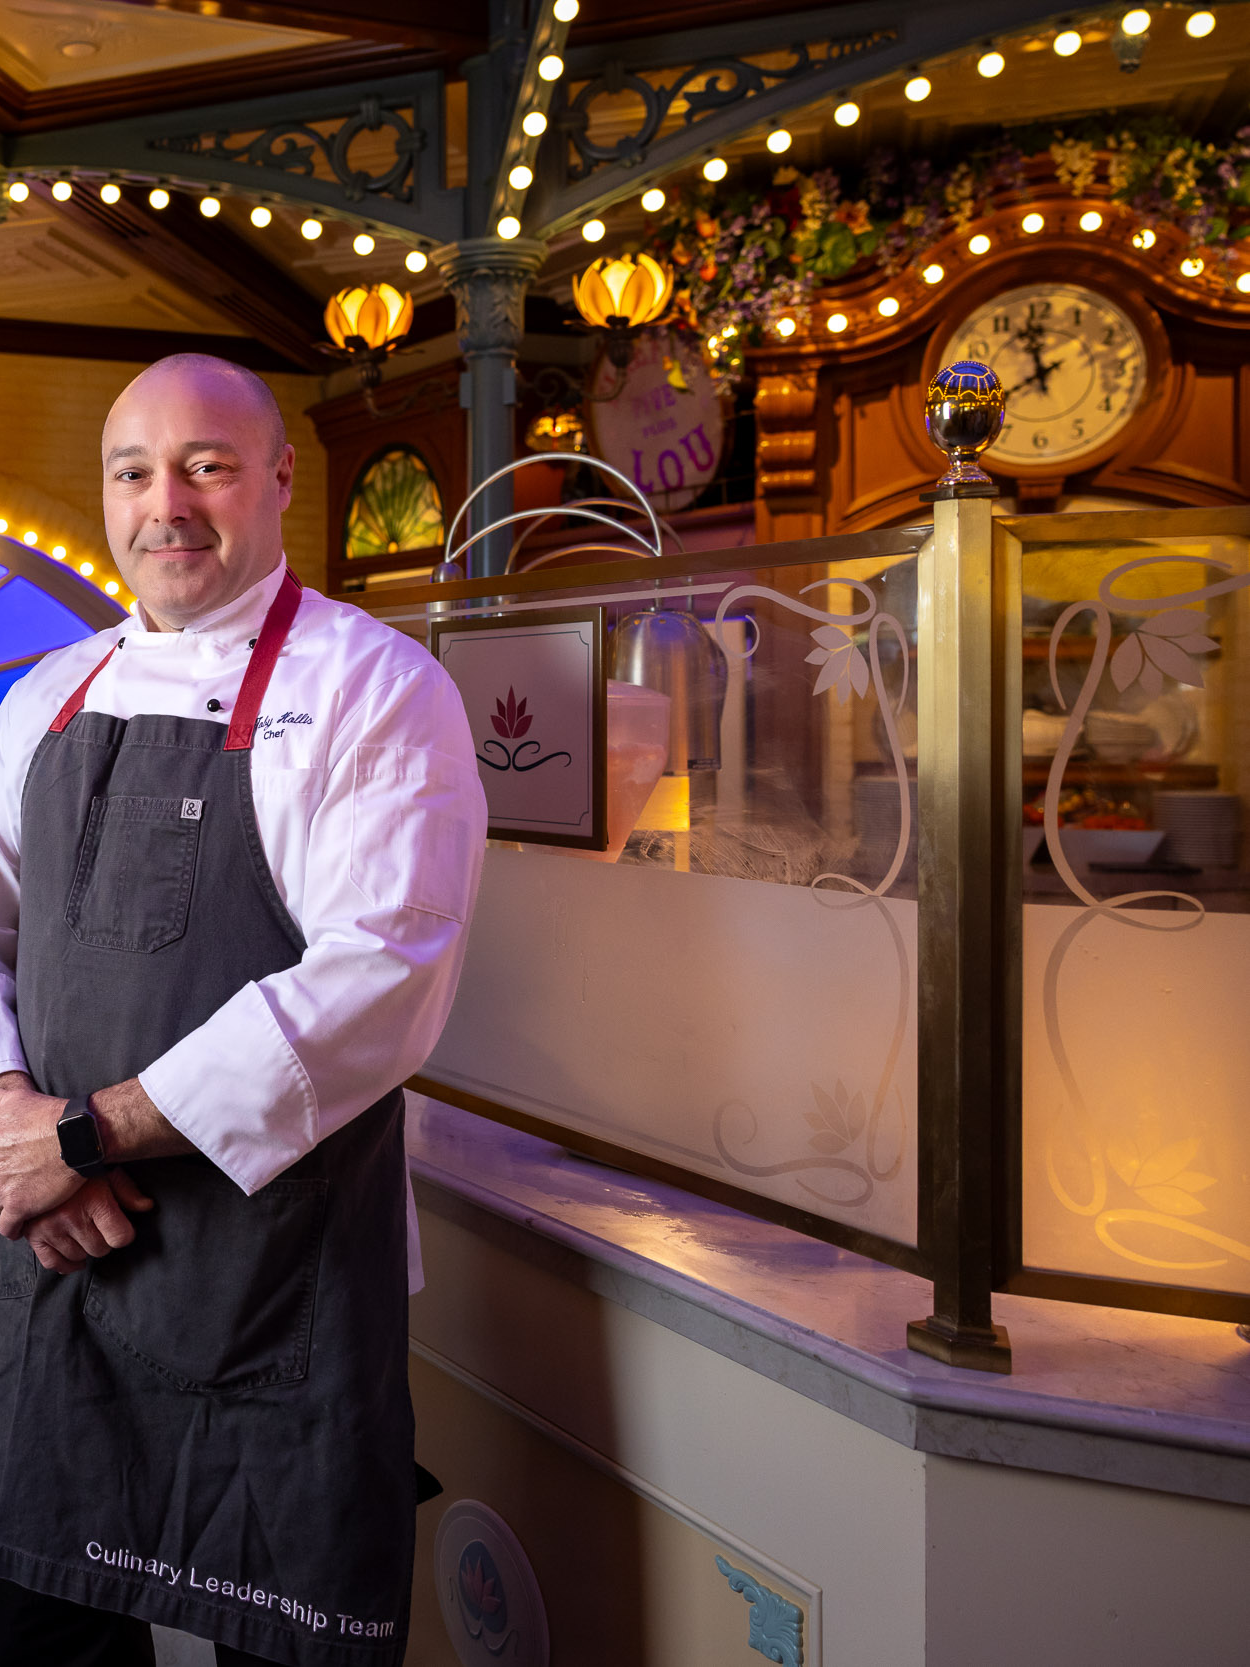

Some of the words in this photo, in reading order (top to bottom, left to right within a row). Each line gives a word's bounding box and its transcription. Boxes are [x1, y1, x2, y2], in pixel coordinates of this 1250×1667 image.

[1028, 302, 1052, 319] 12
[1074, 308, 1081, 326] 1
[993, 316, 1010, 333] 11
[1103, 326, 1115, 346] 2
[967, 340, 989, 359] 10
[1096, 395, 1111, 412] 4
[1071, 418, 1084, 439] 5
[1032, 431, 1048, 449] 6
[263, 728, 285, 740] Chef
[187, 802, 197, 816] &
[86, 1541, 182, 1585] Culinary
[189, 1567, 328, 1632] Leadership
[336, 1613, 394, 1638] Team
